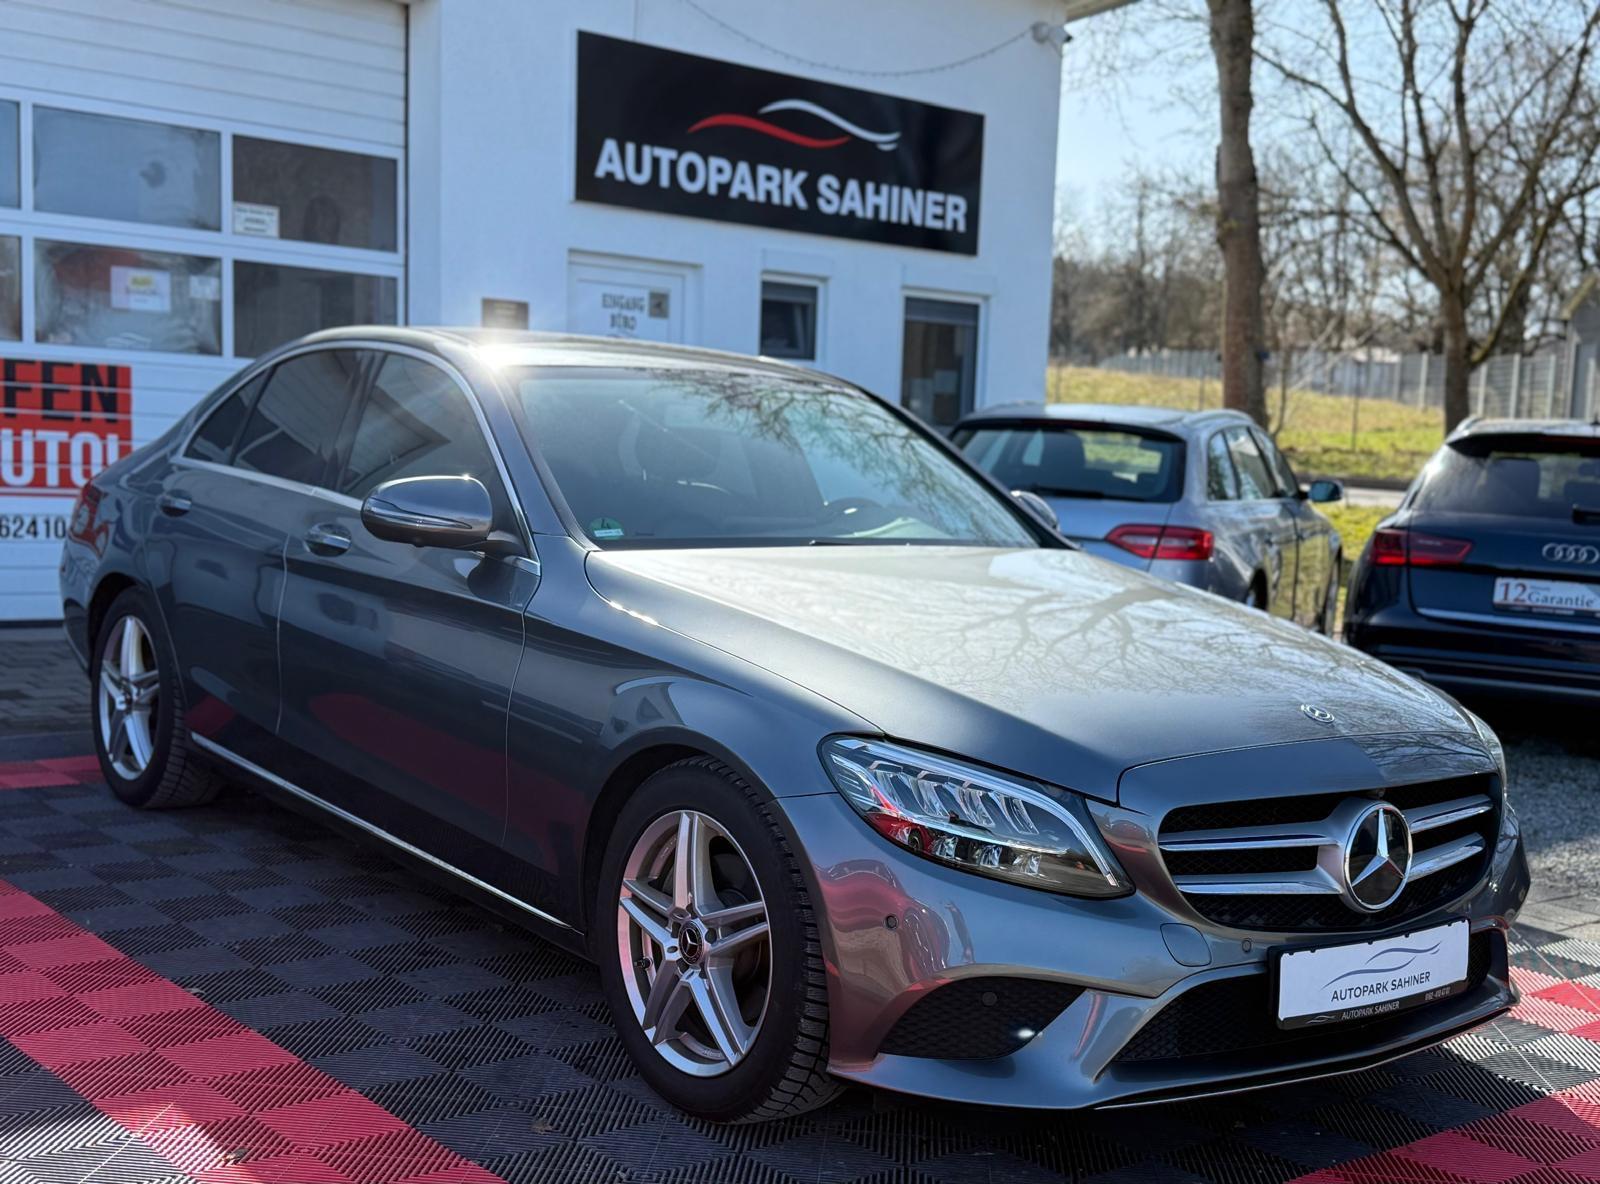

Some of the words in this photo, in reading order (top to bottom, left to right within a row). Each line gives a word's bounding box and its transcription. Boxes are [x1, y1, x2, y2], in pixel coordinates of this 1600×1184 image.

[595, 138, 807, 210] AUTOPARK
[817, 174, 967, 233] SAHINER
[4, 359, 118, 423] FEN
[1500, 582, 1527, 603] 12
[1528, 591, 1595, 608] Garantie
[1331, 980, 1389, 1003] AUTOPARK
[1391, 971, 1431, 993] SAHINER
[1341, 1006, 1374, 1021] AUTOPARK
[1374, 1000, 1400, 1015] SAHINER
